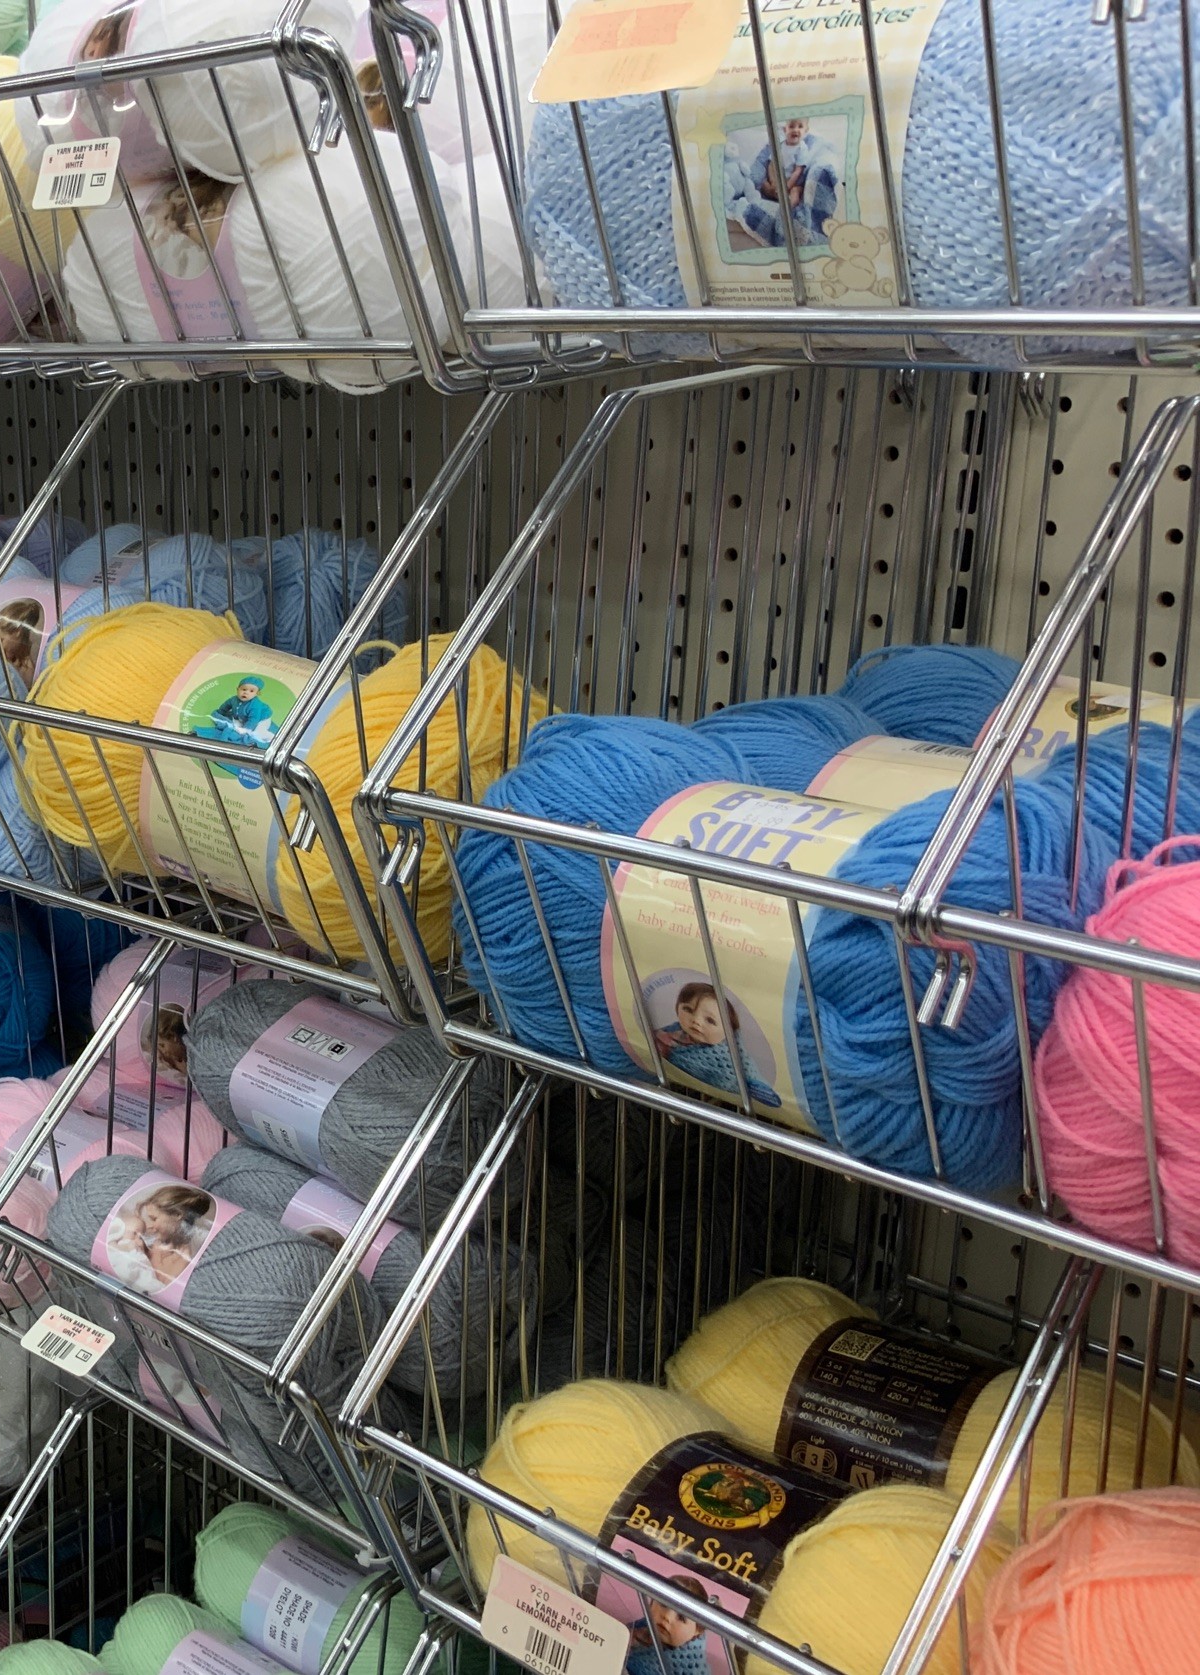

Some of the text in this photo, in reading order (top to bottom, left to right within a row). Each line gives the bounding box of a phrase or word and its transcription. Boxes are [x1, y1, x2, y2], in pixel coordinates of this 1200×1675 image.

[773, 5, 917, 34] Coordintes
[56, 142, 109, 156] YARN BABY'S BEST
[65, 160, 84, 169] WHITE
[179, 779, 206, 795] Knit this
[740, 894, 781, 917] weight
[720, 909, 742, 927] fun
[636, 909, 769, 958] baby and kd's colors.
[59, 1312, 106, 1339] YARN BABY'S BEST
[62, 1328, 77, 1338] GREY
[818, 1370, 832, 1381] 140
[886, 1390, 902, 1401] 420
[870, 1409, 898, 1424] NYLON
[876, 1423, 904, 1438] NYLON
[810, 1435, 825, 1446] Light
[706, 1464, 747, 1473] LION
[810, 1453, 818, 1467] 3
[685, 1500, 736, 1529] YARNS
[626, 1503, 758, 1582] Baby Soft
[288, 1593, 302, 1617] SHADE
[297, 1599, 313, 1624] SHADE
[530, 1584, 590, 1625] 920 160
[516, 1598, 562, 1633] LEMONADE
[535, 1599, 606, 1648] YARN BABYSOFT
[501, 1625, 509, 1634] 6
